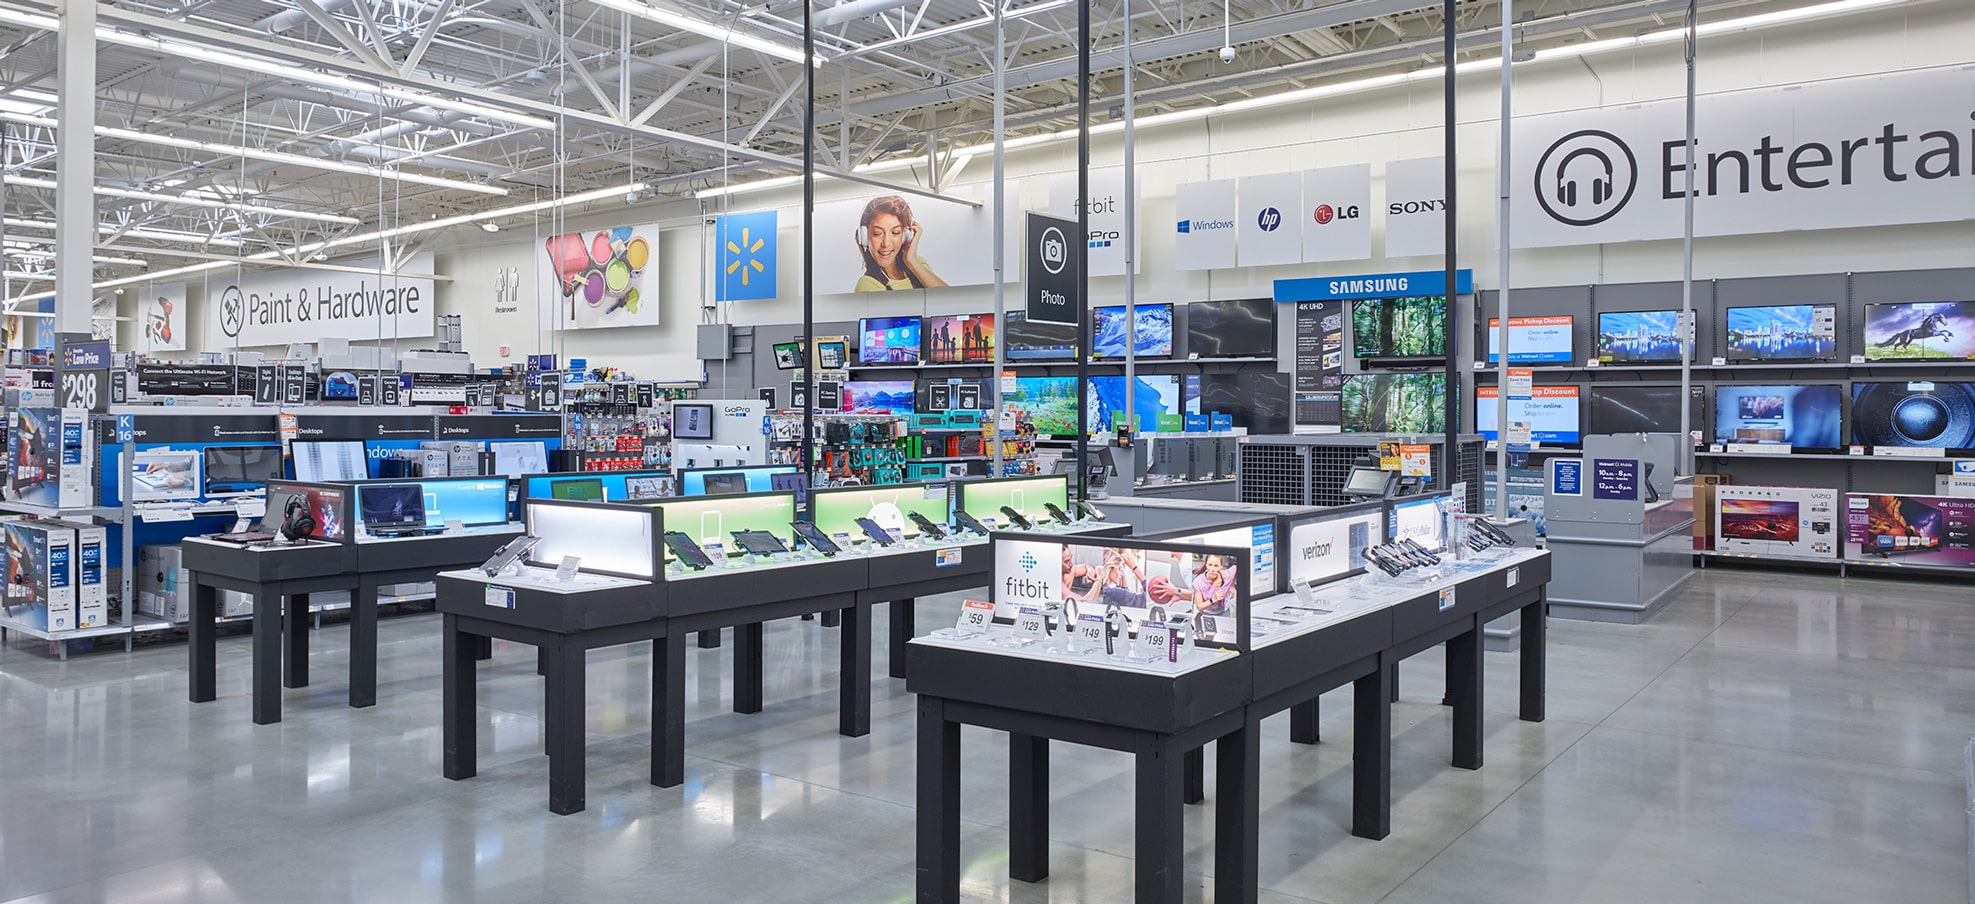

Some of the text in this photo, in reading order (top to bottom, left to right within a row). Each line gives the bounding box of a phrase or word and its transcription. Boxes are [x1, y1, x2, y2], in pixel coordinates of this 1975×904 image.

[1074, 196, 1115, 216] fbit
[1337, 205, 1359, 220] LG
[1193, 219, 1234, 231] Windows
[1260, 207, 1278, 232] hp
[1087, 230, 1120, 241] Pro
[1329, 277, 1408, 295] SAMSUNG
[249, 281, 420, 326] Paint & Hardware
[1041, 289, 1066, 306] Photo
[495, 306, 518, 314] Restrooms
[1299, 303, 1309, 311] 4K
[1523, 318, 1543, 326] Pickup
[1543, 317, 1570, 325] Discount
[72, 352, 99, 365] Low Price
[62, 372, 97, 410] $298
[1543, 387, 1576, 396] Discount
[724, 406, 751, 414] GoPro
[120, 416, 130, 427] K
[118, 430, 132, 441] 16
[1302, 541, 1331, 560] verizon
[1005, 576, 1049, 600] fitbit
[968, 612, 984, 625] $59
[1022, 621, 1040, 632] $129
[1082, 626, 1100, 639] $149
[1145, 635, 1164, 646] $199
